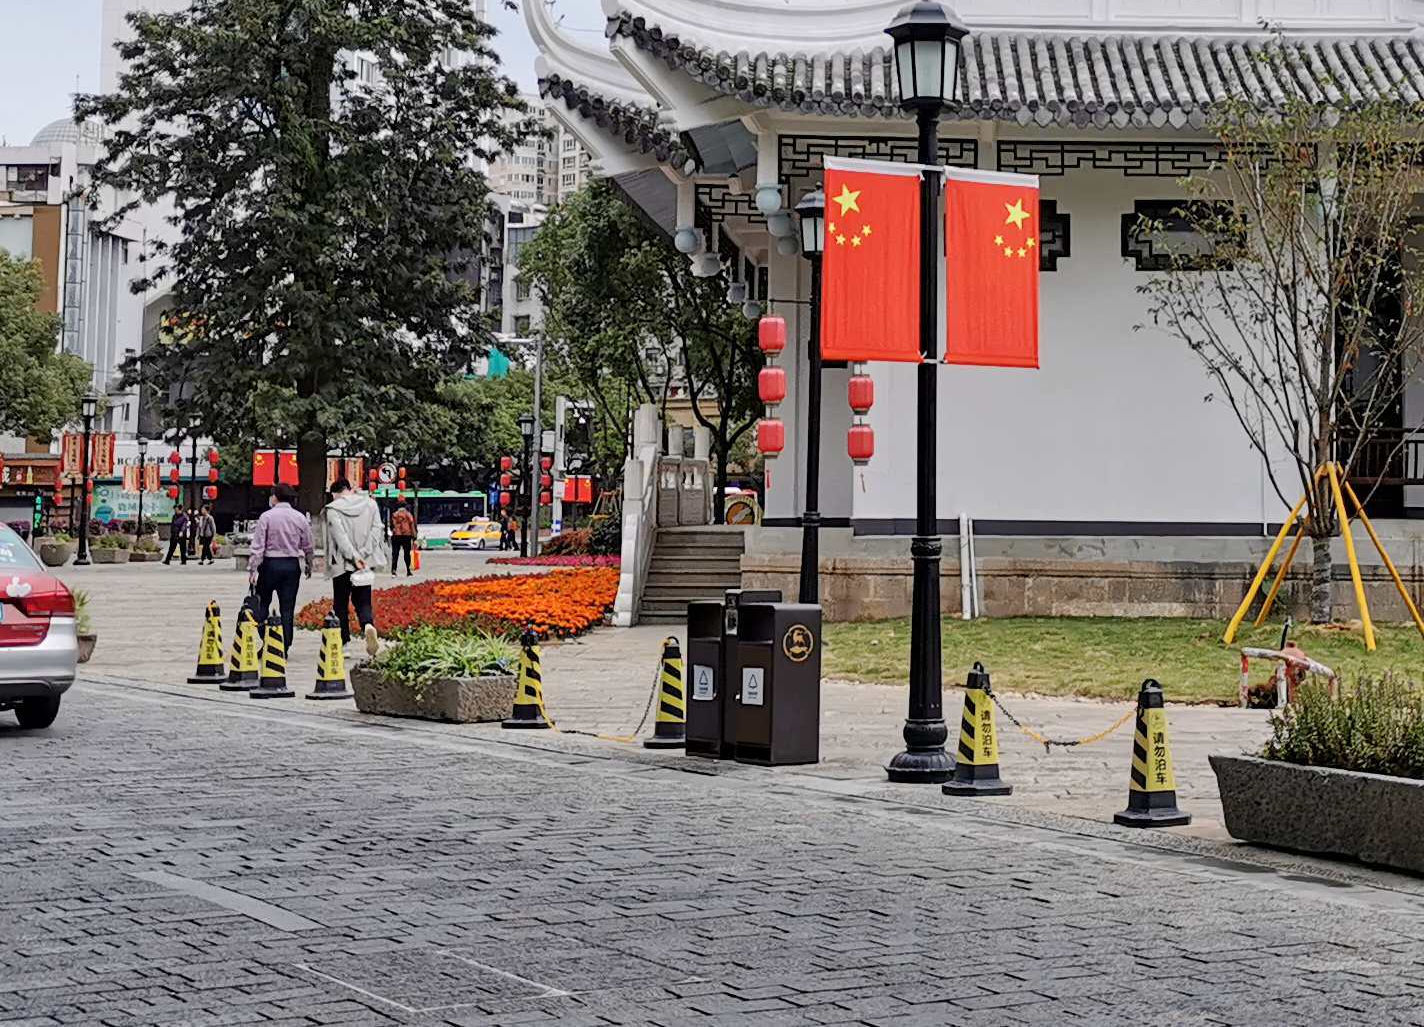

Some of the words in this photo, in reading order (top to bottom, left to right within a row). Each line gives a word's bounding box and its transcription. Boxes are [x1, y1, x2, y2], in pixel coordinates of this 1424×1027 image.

[980, 709, 993, 758] 请勿泊车
[1152, 731, 1168, 785] 请勿泊车
